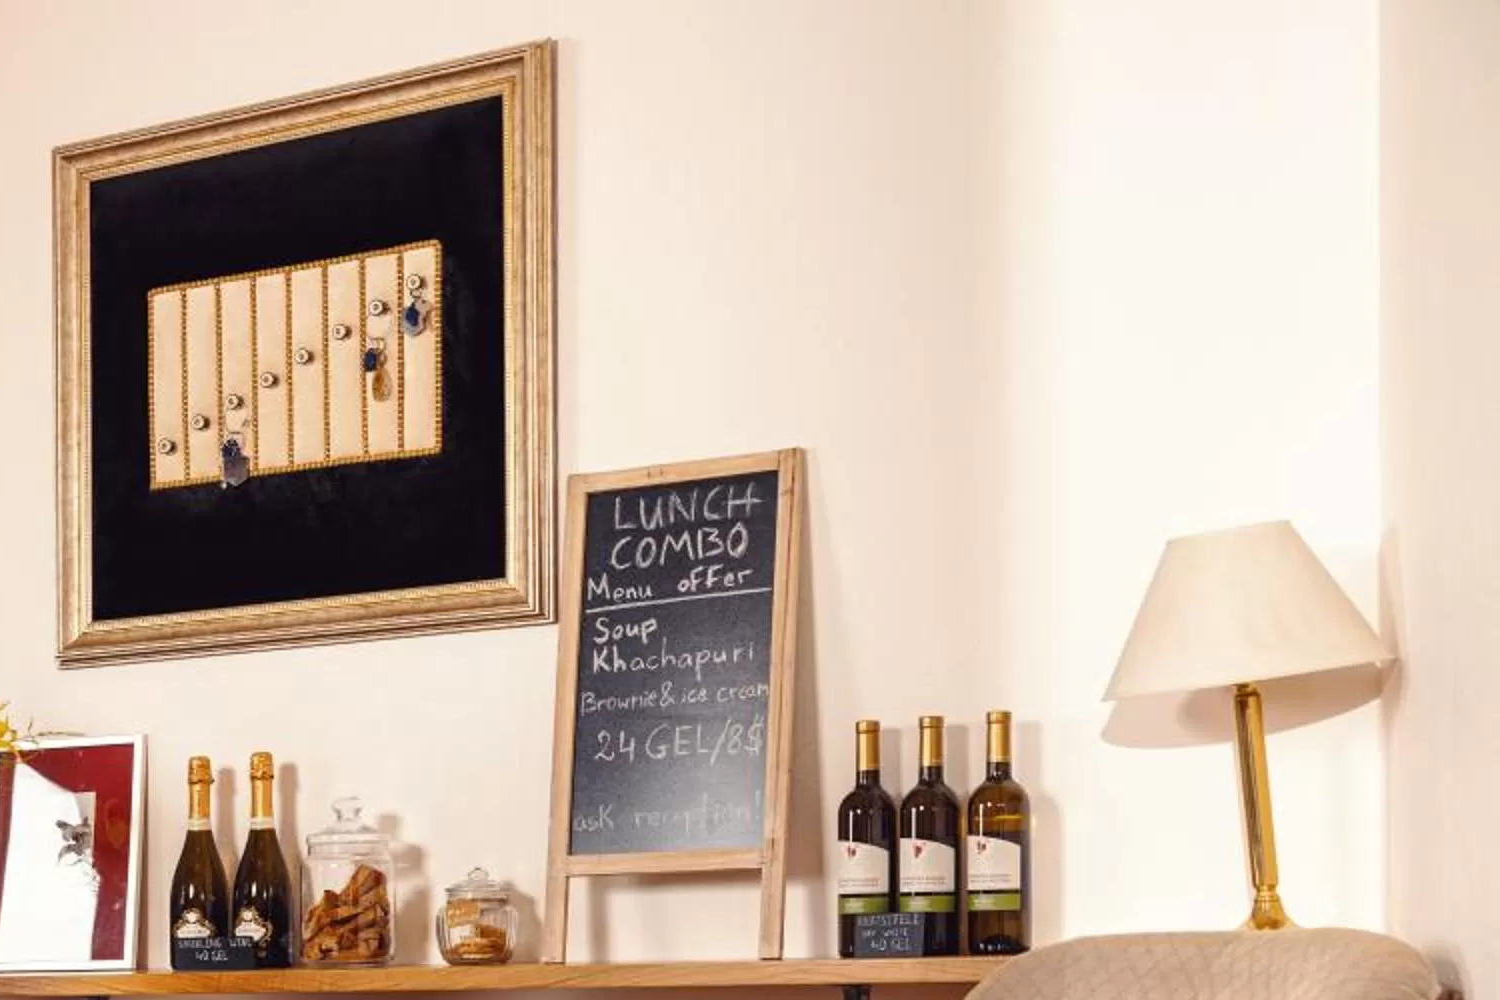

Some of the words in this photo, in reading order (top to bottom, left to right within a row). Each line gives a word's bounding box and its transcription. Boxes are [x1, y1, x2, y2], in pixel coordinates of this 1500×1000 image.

[614, 481, 764, 531] LUNCH
[609, 521, 750, 571] COMBO
[587, 572, 653, 603] Menu
[593, 616, 658, 645] Soup
[592, 636, 755, 682] Khachapuri
[716, 682, 770, 702] cream
[593, 729, 637, 764] 24
